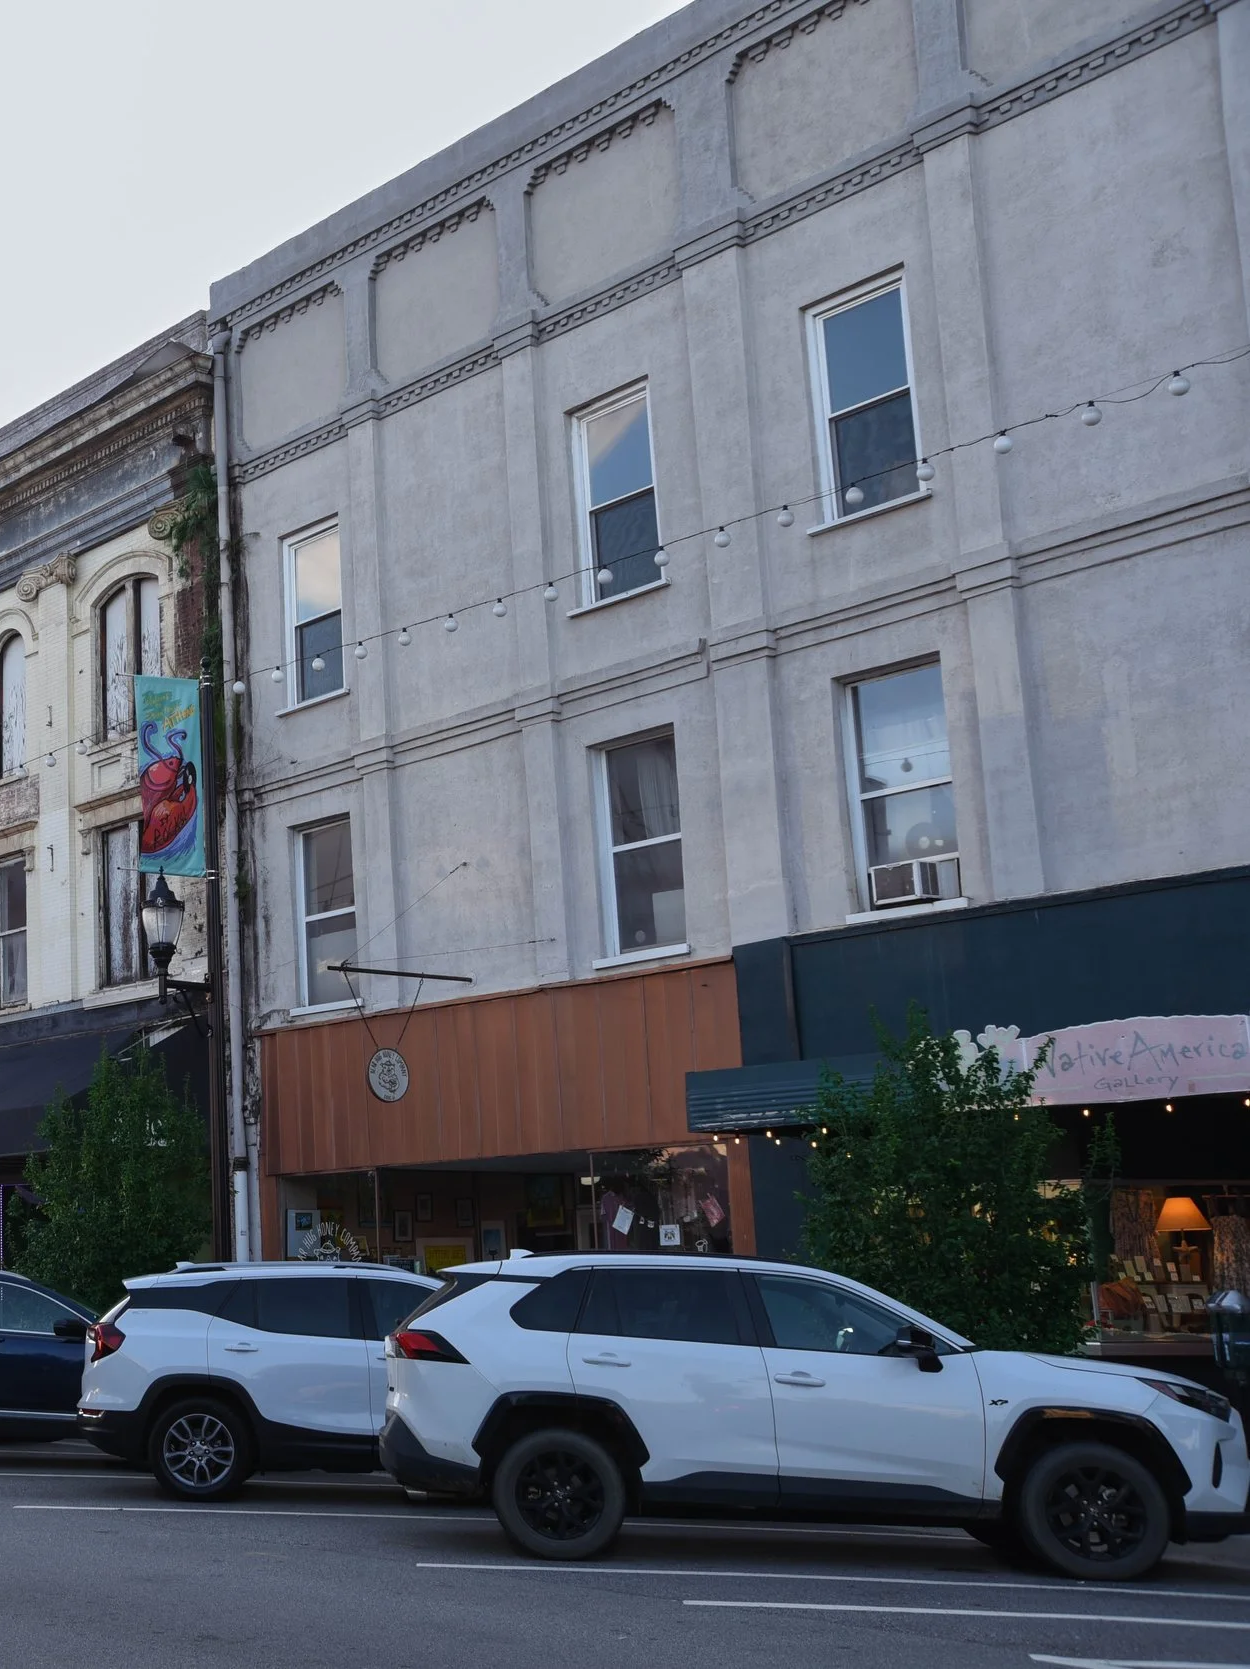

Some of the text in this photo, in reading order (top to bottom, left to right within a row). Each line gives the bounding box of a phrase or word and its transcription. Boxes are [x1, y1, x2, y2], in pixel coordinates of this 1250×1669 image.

[302, 1229, 317, 1249] HUG
[316, 1222, 341, 1238] HONEY
[340, 1228, 362, 1263] COMPAN
